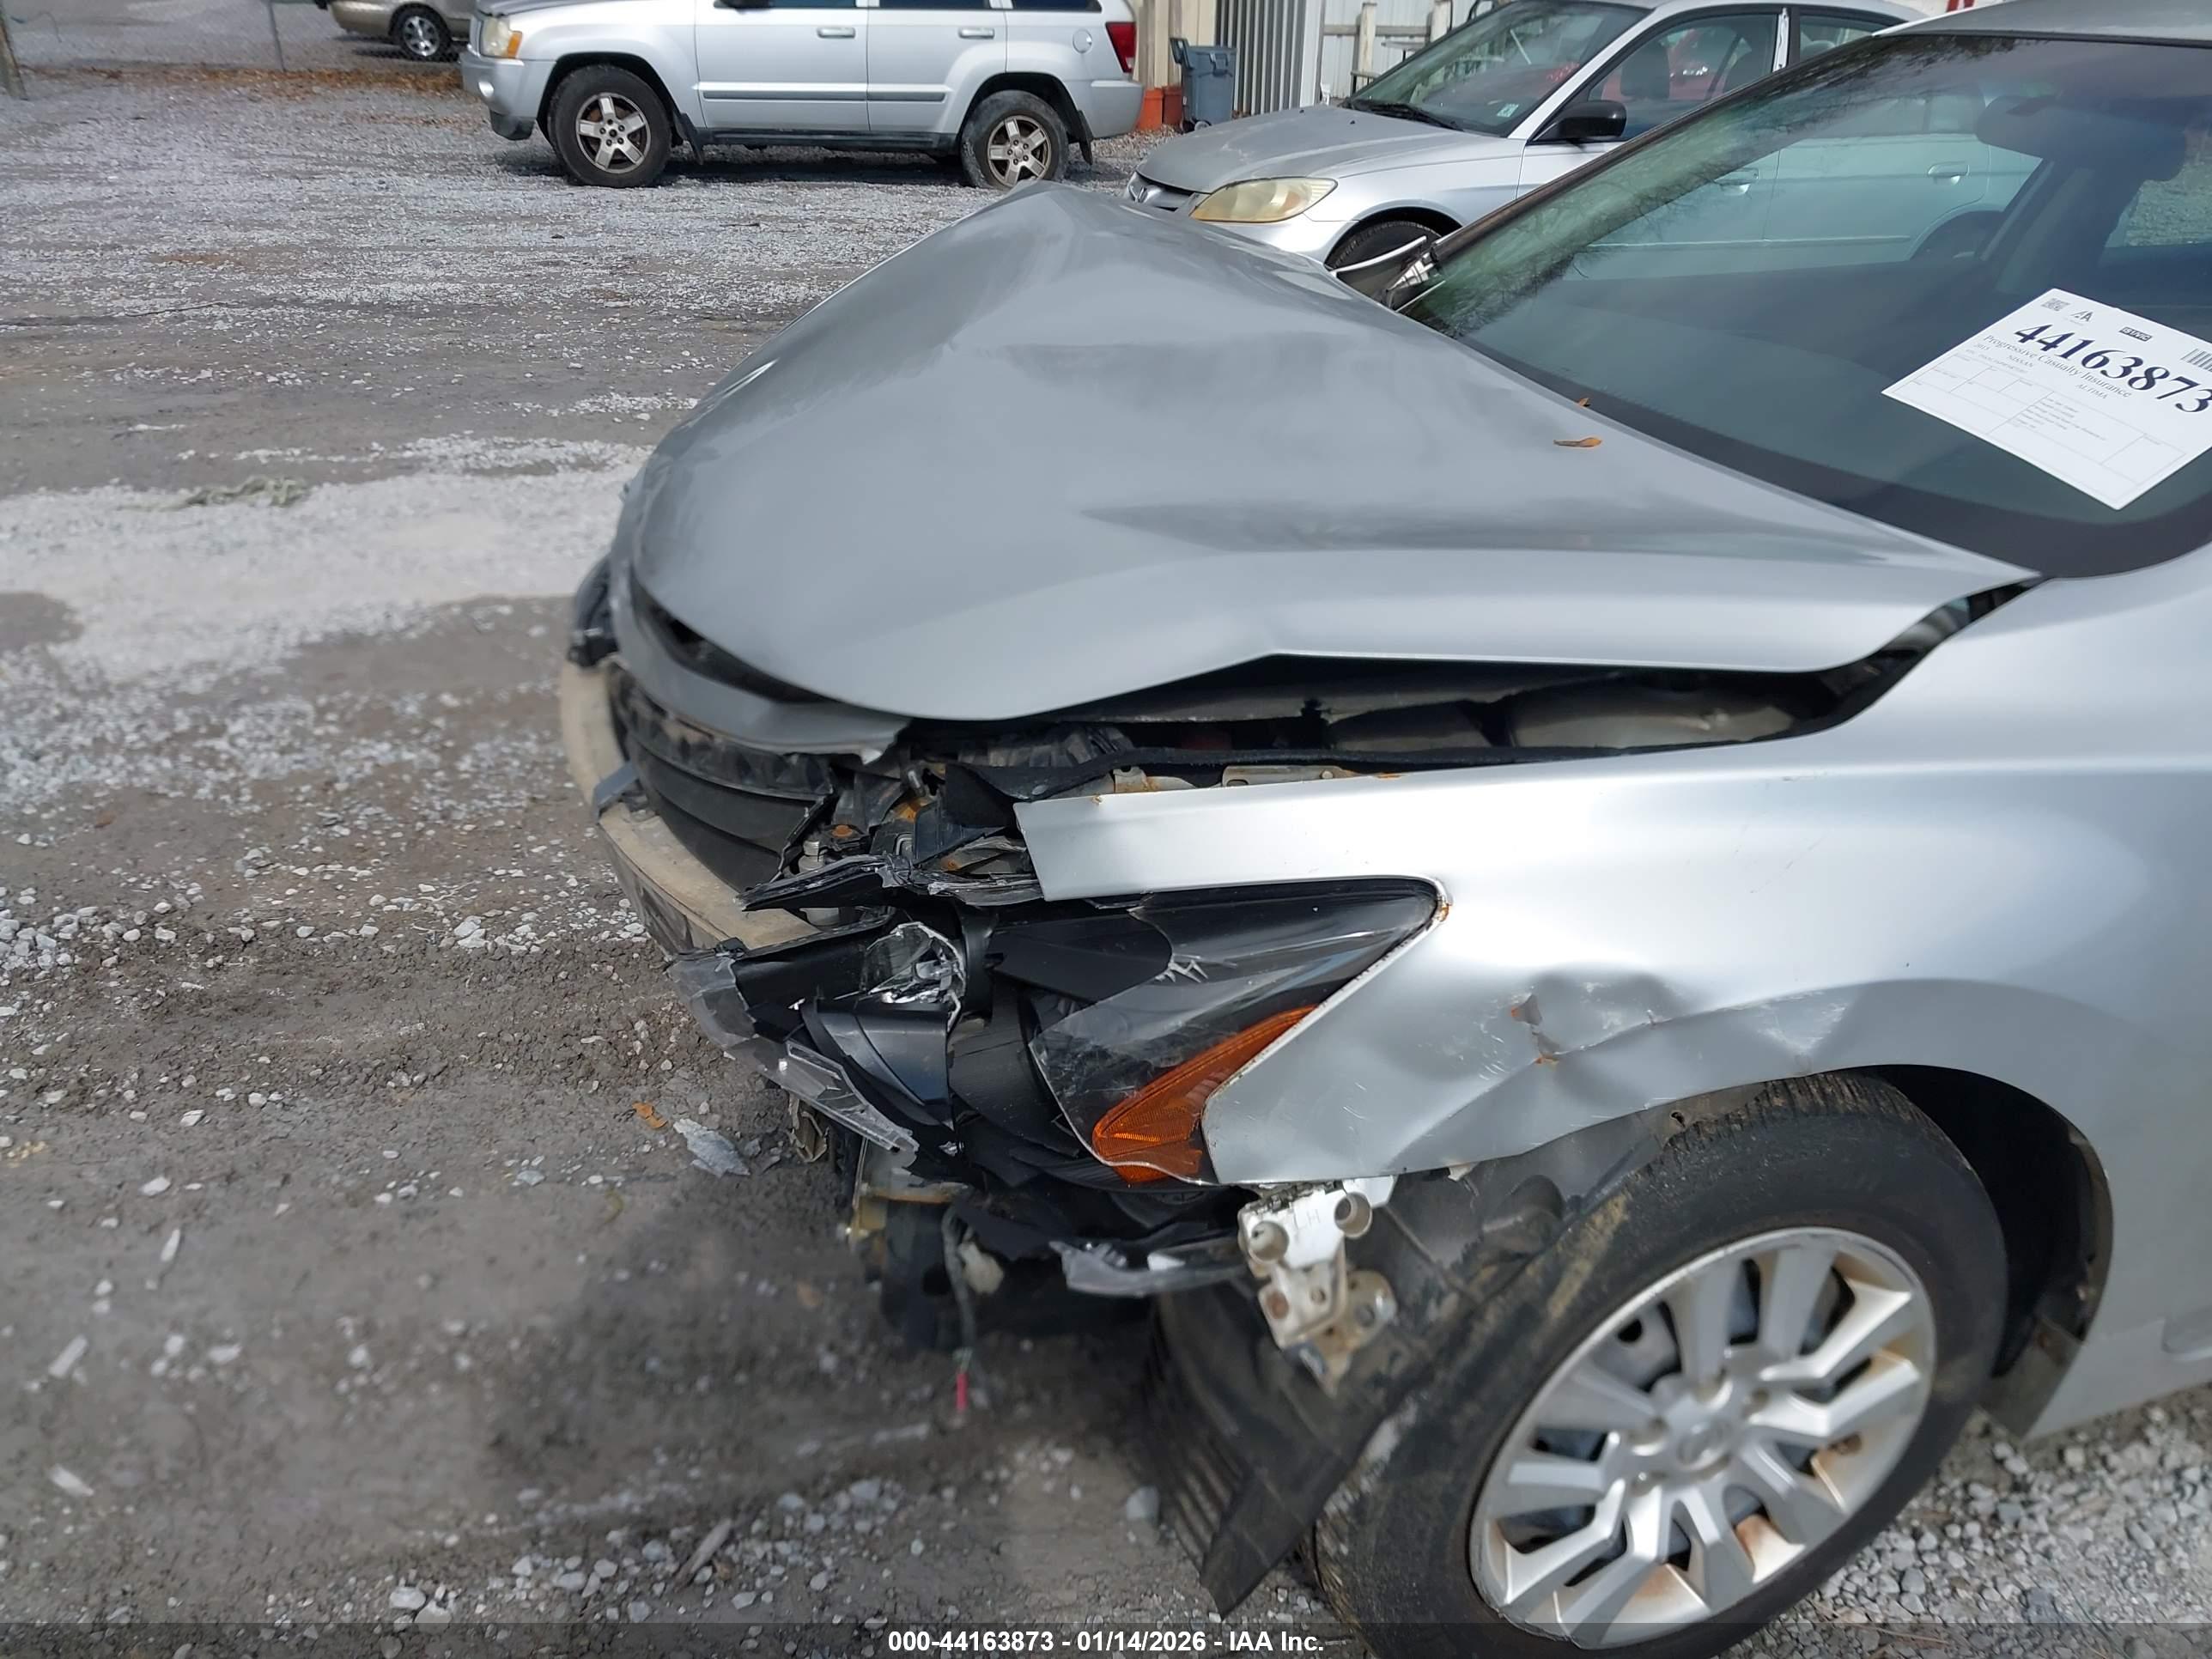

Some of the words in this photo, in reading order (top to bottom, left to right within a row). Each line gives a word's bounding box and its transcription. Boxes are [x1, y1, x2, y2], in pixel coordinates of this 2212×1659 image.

[1984, 335, 2037, 359] Progressive
[2038, 354, 2082, 377] Casualty
[2081, 372, 2132, 398] Insurance
[2014, 324, 2212, 413] 44163873
